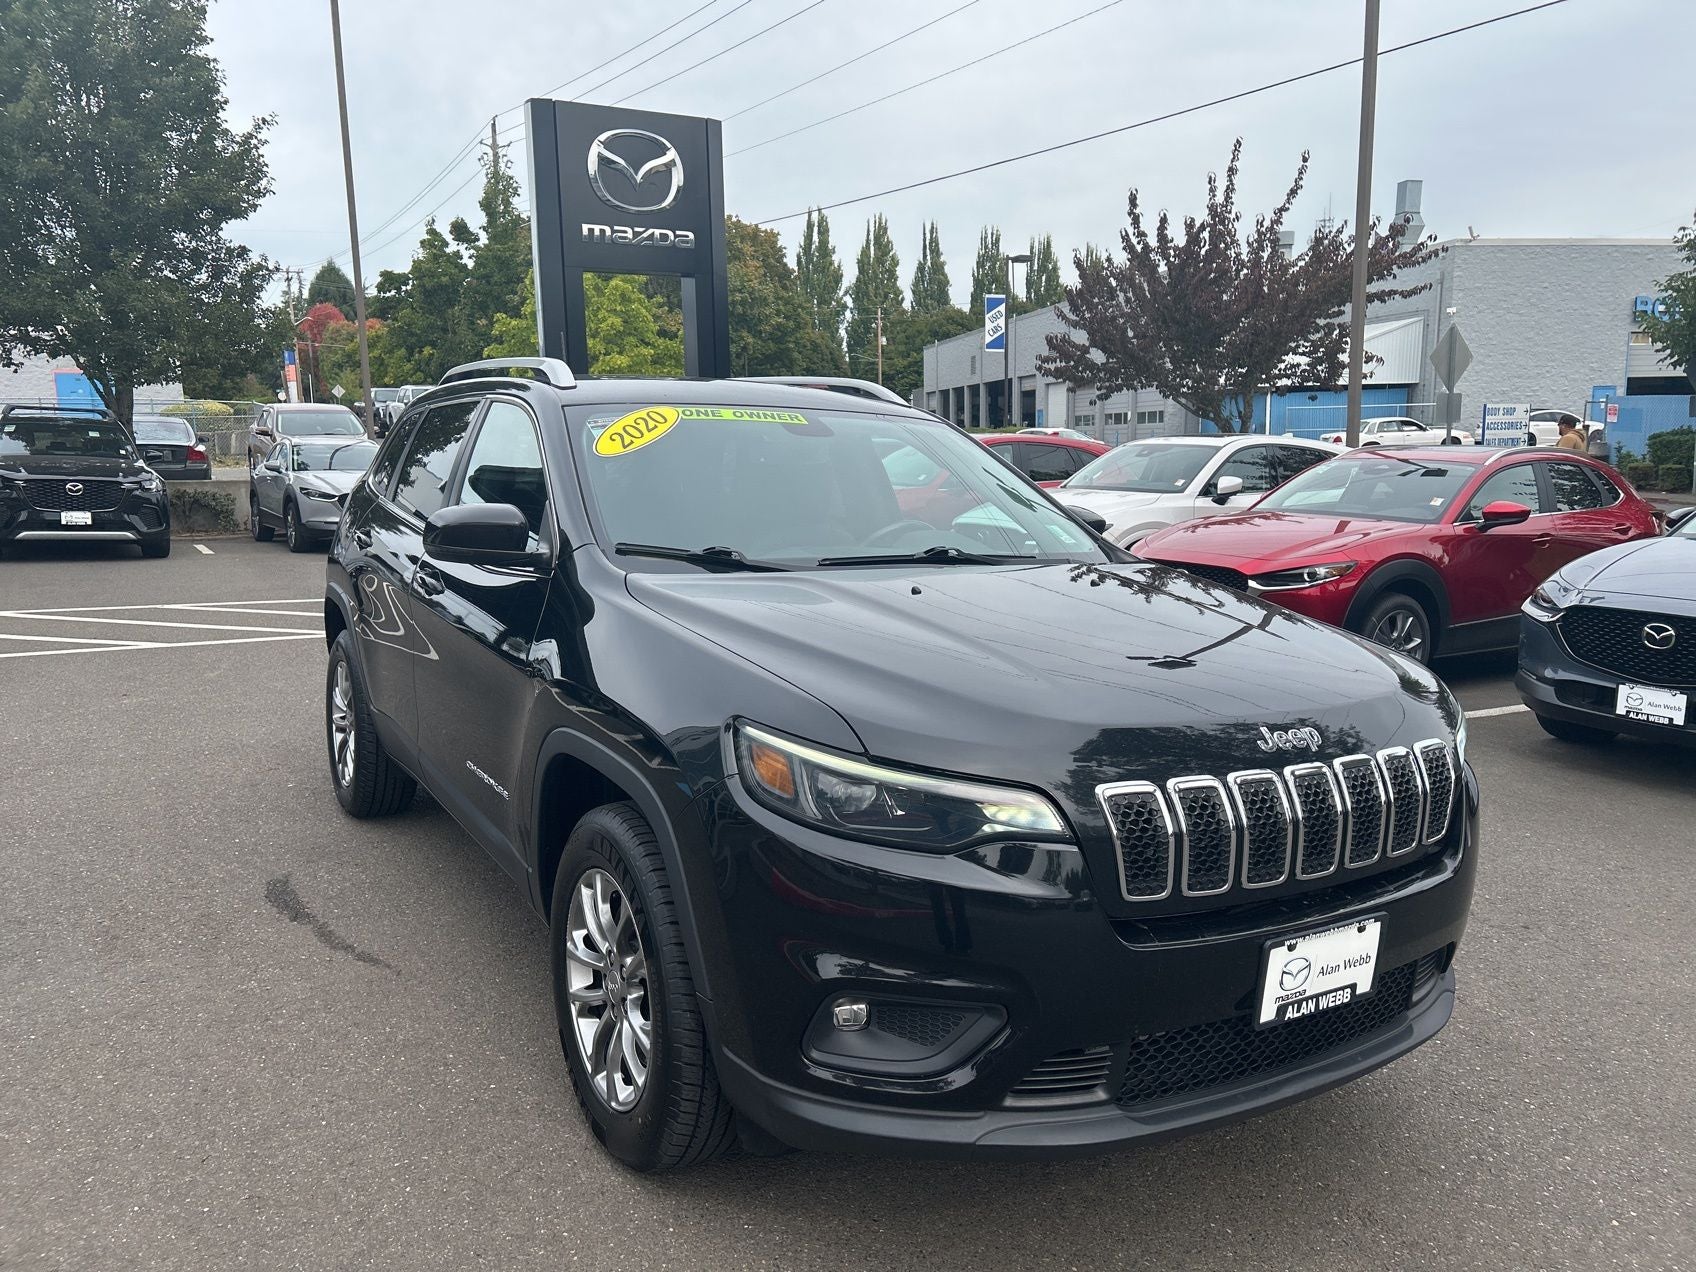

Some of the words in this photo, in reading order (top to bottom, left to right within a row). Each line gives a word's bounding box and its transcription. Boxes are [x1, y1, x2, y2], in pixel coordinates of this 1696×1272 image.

[581, 223, 695, 249] mazda
[988, 310, 1003, 323] USED
[987, 323, 1002, 337] CARS
[682, 408, 723, 418] ONE
[733, 410, 802, 422] OWNER
[1487, 407, 1500, 416] BODY
[1502, 406, 1516, 416] SHOP
[609, 410, 668, 449] 2020
[1486, 421, 1523, 430] ACCESSORIES
[1647, 701, 1662, 709] Alan
[1663, 704, 1682, 712] Webb
[1629, 711, 1647, 721] ALAN
[1648, 715, 1670, 724] WEBB
[1257, 726, 1322, 752] Jeep
[1316, 963, 1341, 978] Alan
[1343, 952, 1371, 970] Webb
[1274, 988, 1307, 1004] mazda
[1285, 998, 1316, 1020] ALAN
[1318, 988, 1351, 1010] WEBB
